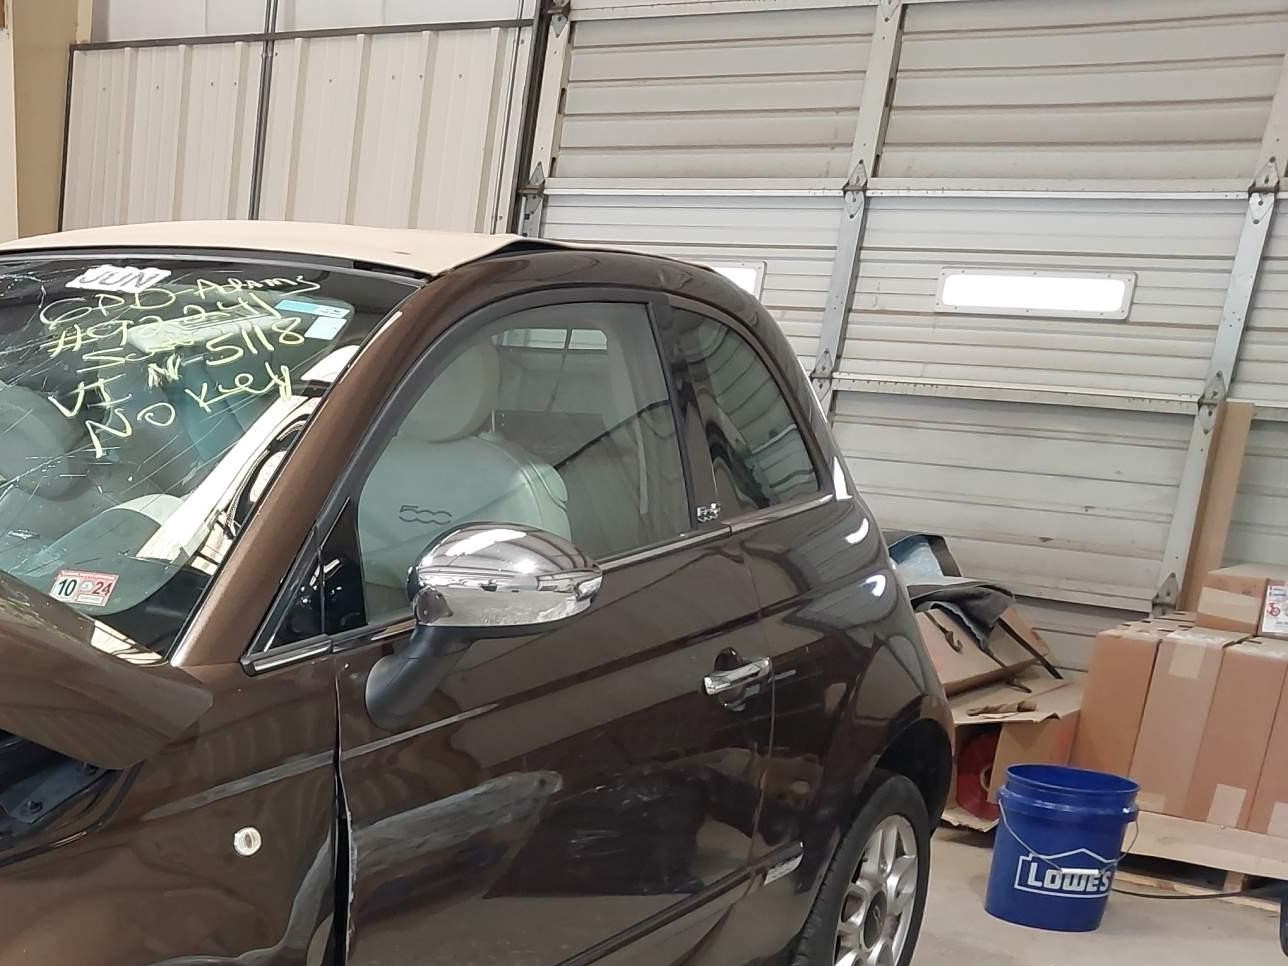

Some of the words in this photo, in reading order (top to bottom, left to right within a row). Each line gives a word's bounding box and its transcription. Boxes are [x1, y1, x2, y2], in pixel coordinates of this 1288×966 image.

[79, 271, 159, 287] JUN
[57, 578, 78, 597] 10
[92, 581, 113, 596] 24
